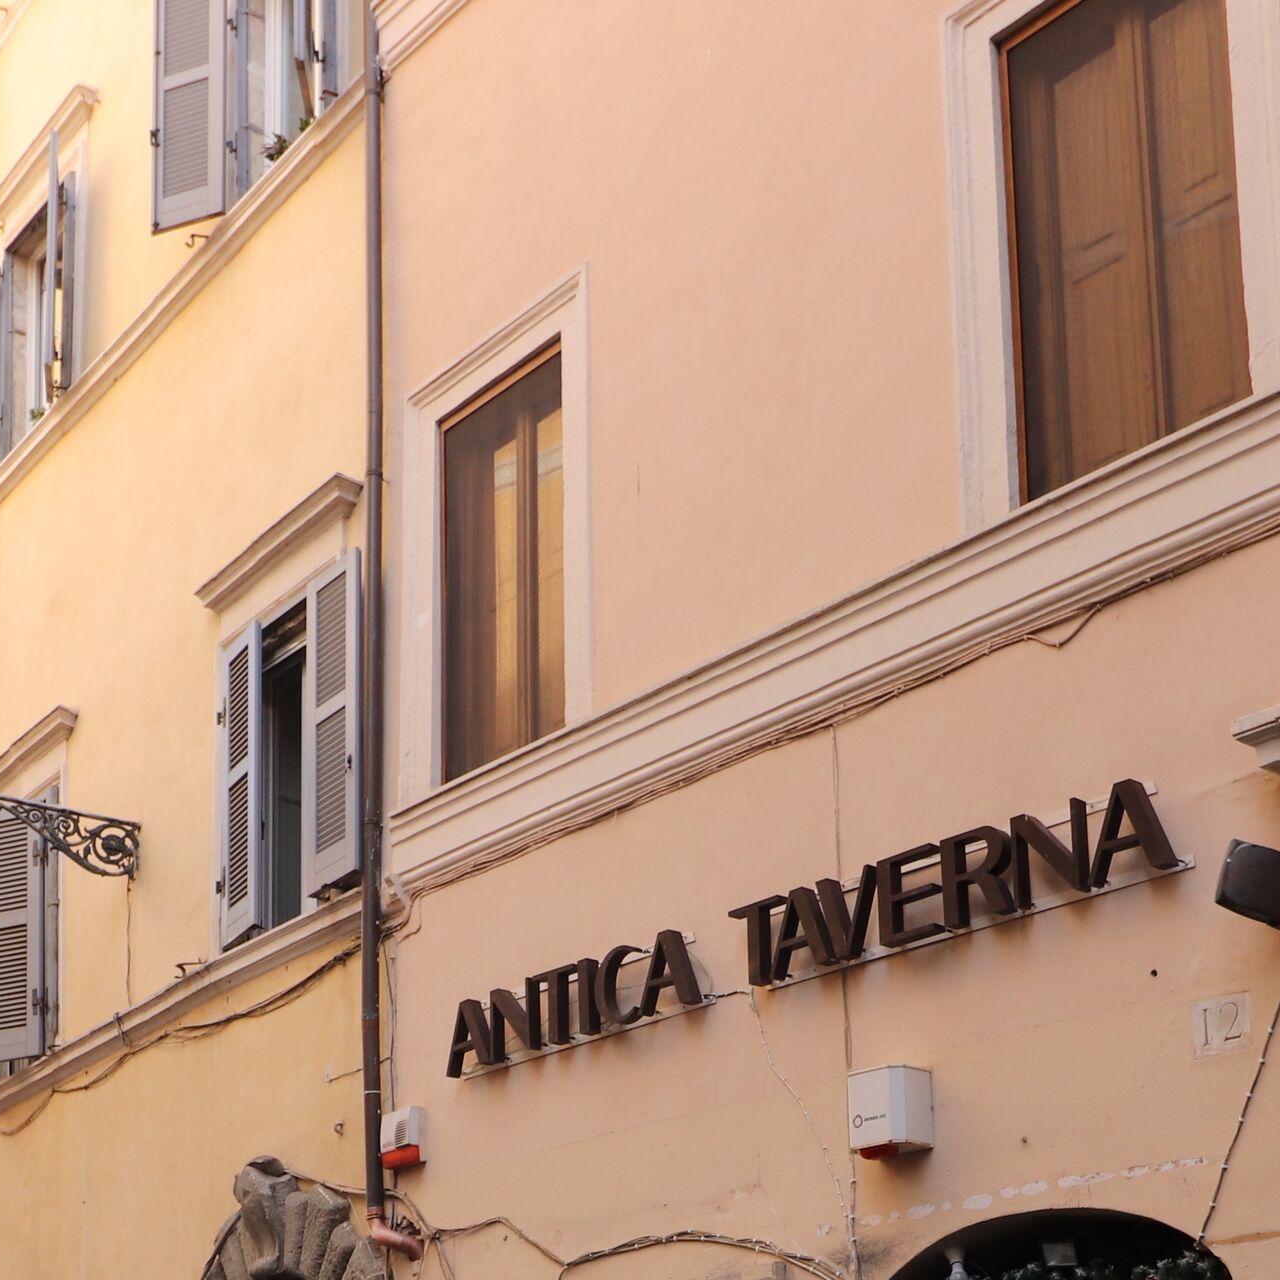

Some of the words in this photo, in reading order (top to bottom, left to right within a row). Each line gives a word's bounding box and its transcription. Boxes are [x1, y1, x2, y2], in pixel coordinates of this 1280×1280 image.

[446, 928, 702, 1078] ANTICA
[727, 778, 1180, 987] TAVERNA
[1201, 1001, 1244, 1047] 12
